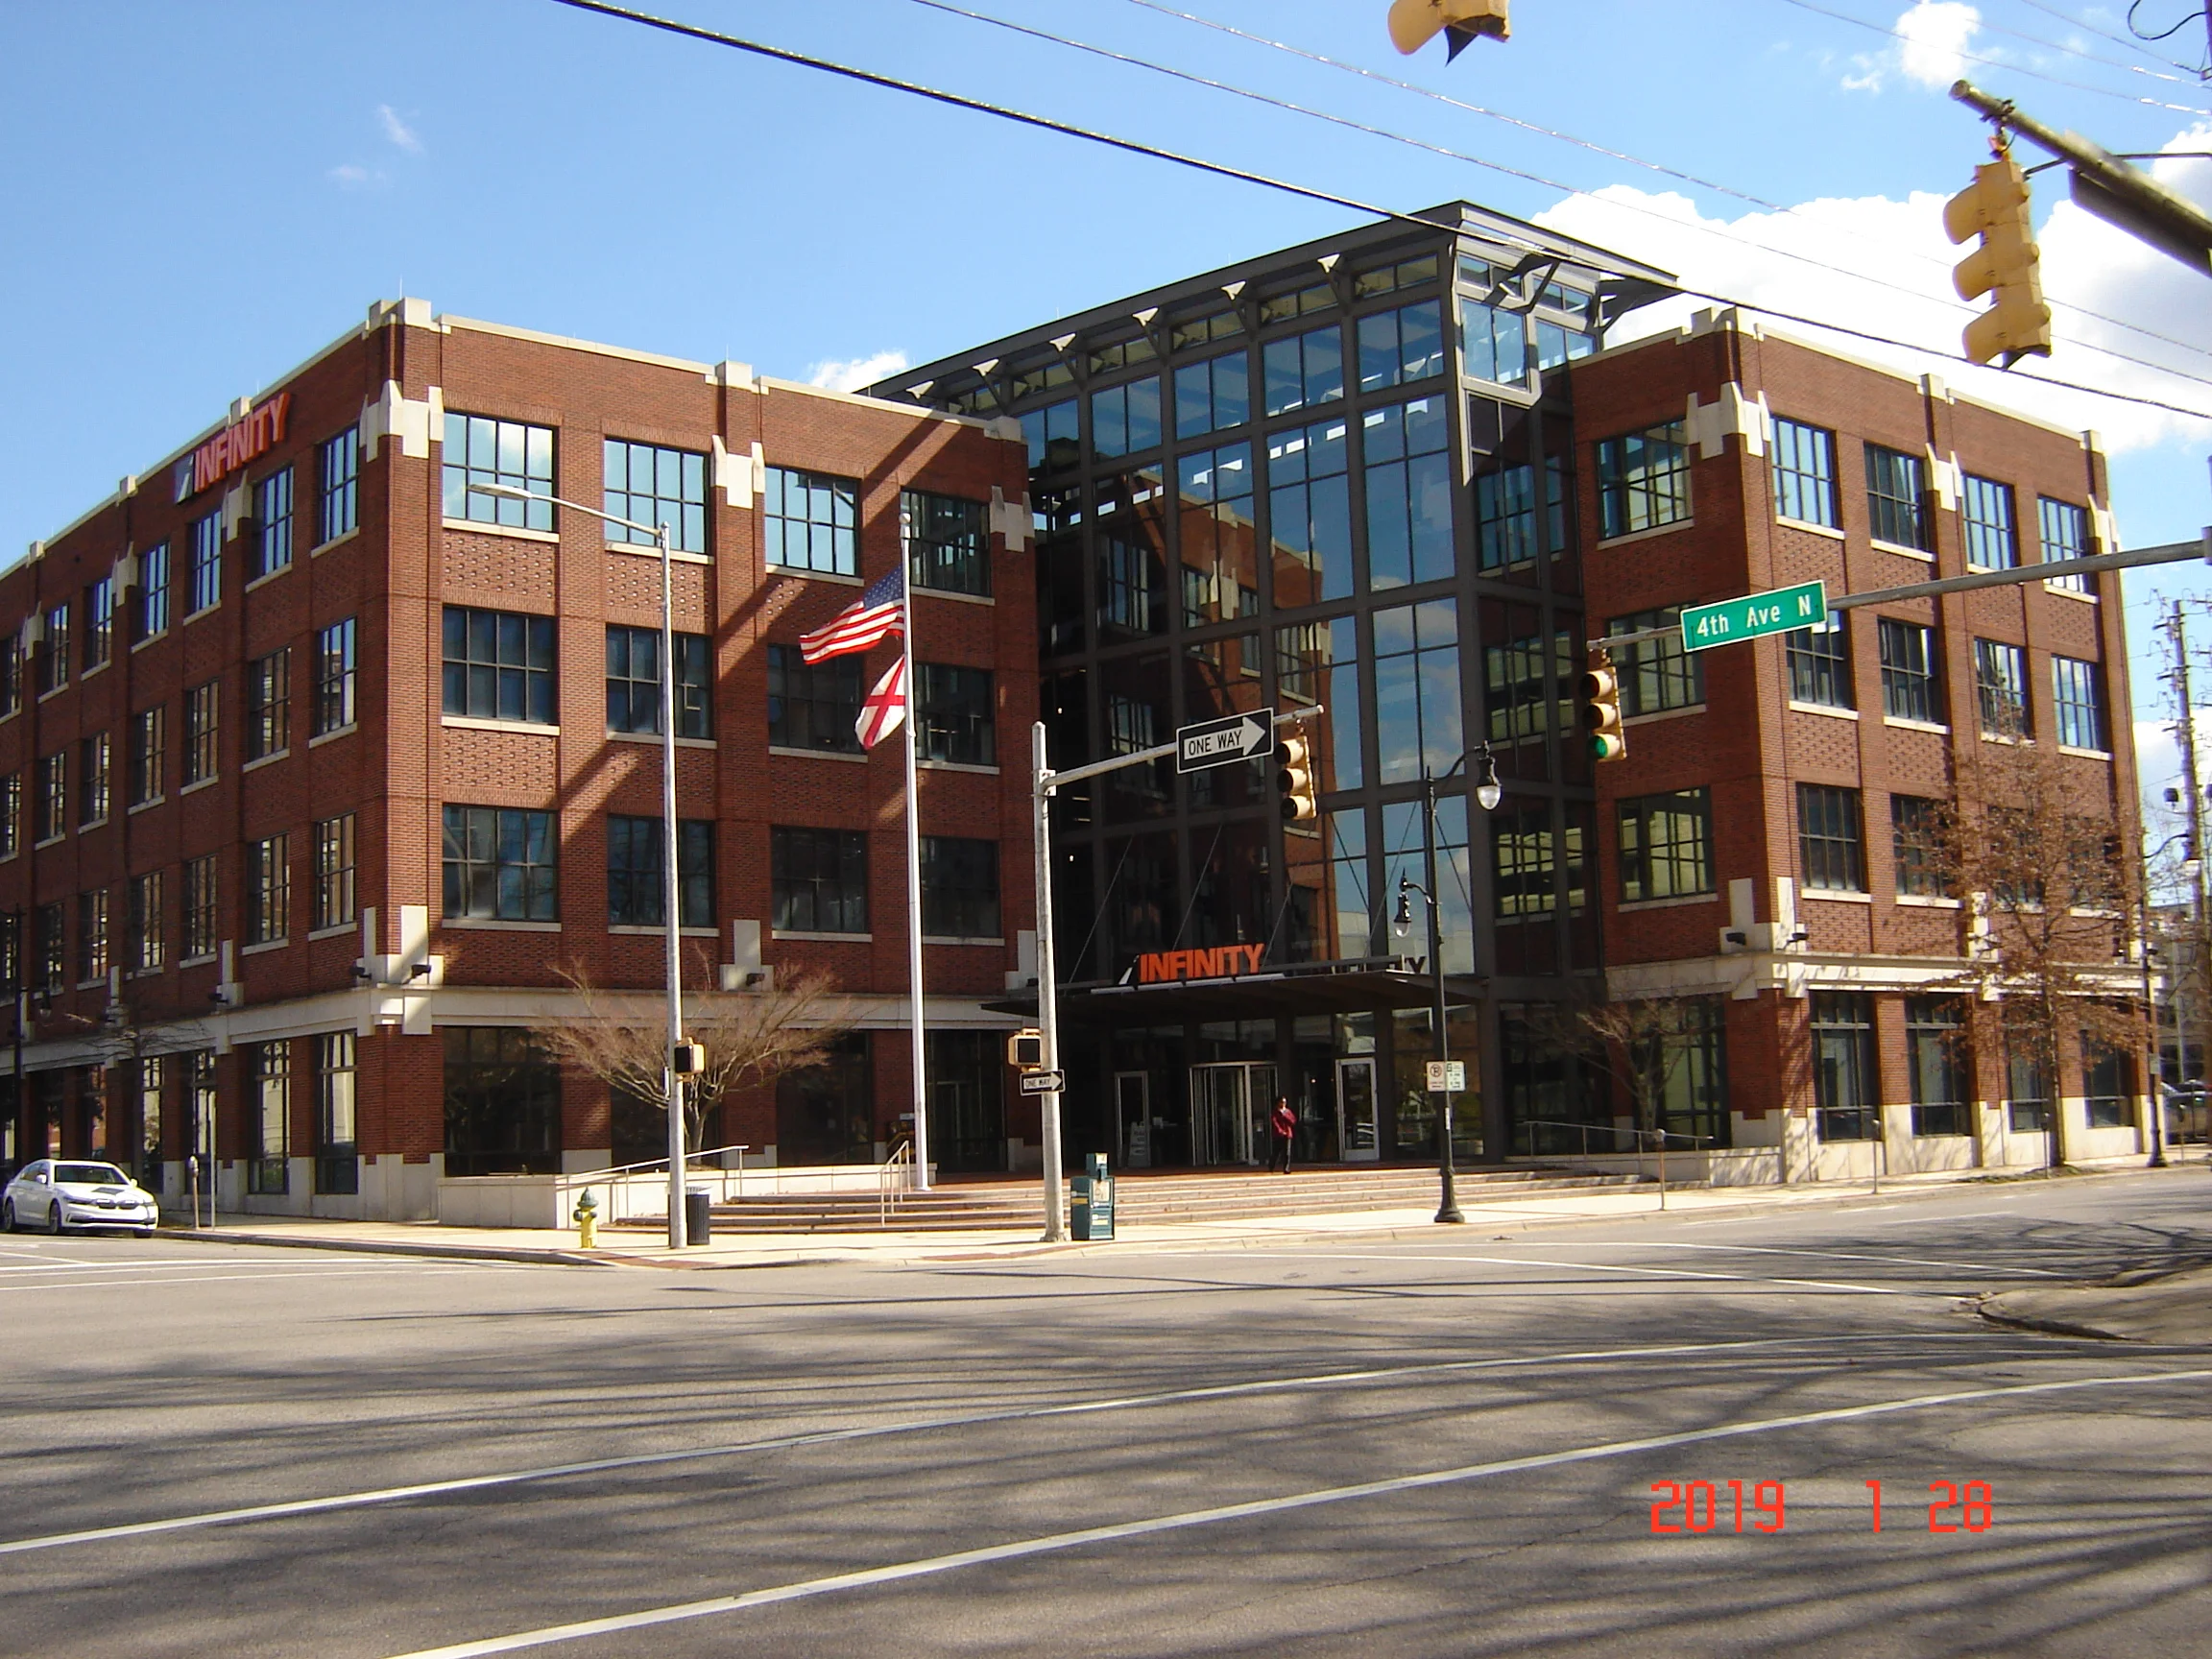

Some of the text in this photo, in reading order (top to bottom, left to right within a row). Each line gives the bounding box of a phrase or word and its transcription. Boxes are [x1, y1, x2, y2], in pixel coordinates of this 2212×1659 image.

[194, 392, 290, 493] INFINITY
[1696, 594, 1812, 637] 4th Ave N
[1189, 730, 1242, 756] ONE WAY
[1139, 943, 1264, 983] INFINITY
[1024, 1077, 1050, 1088] ONE WAY
